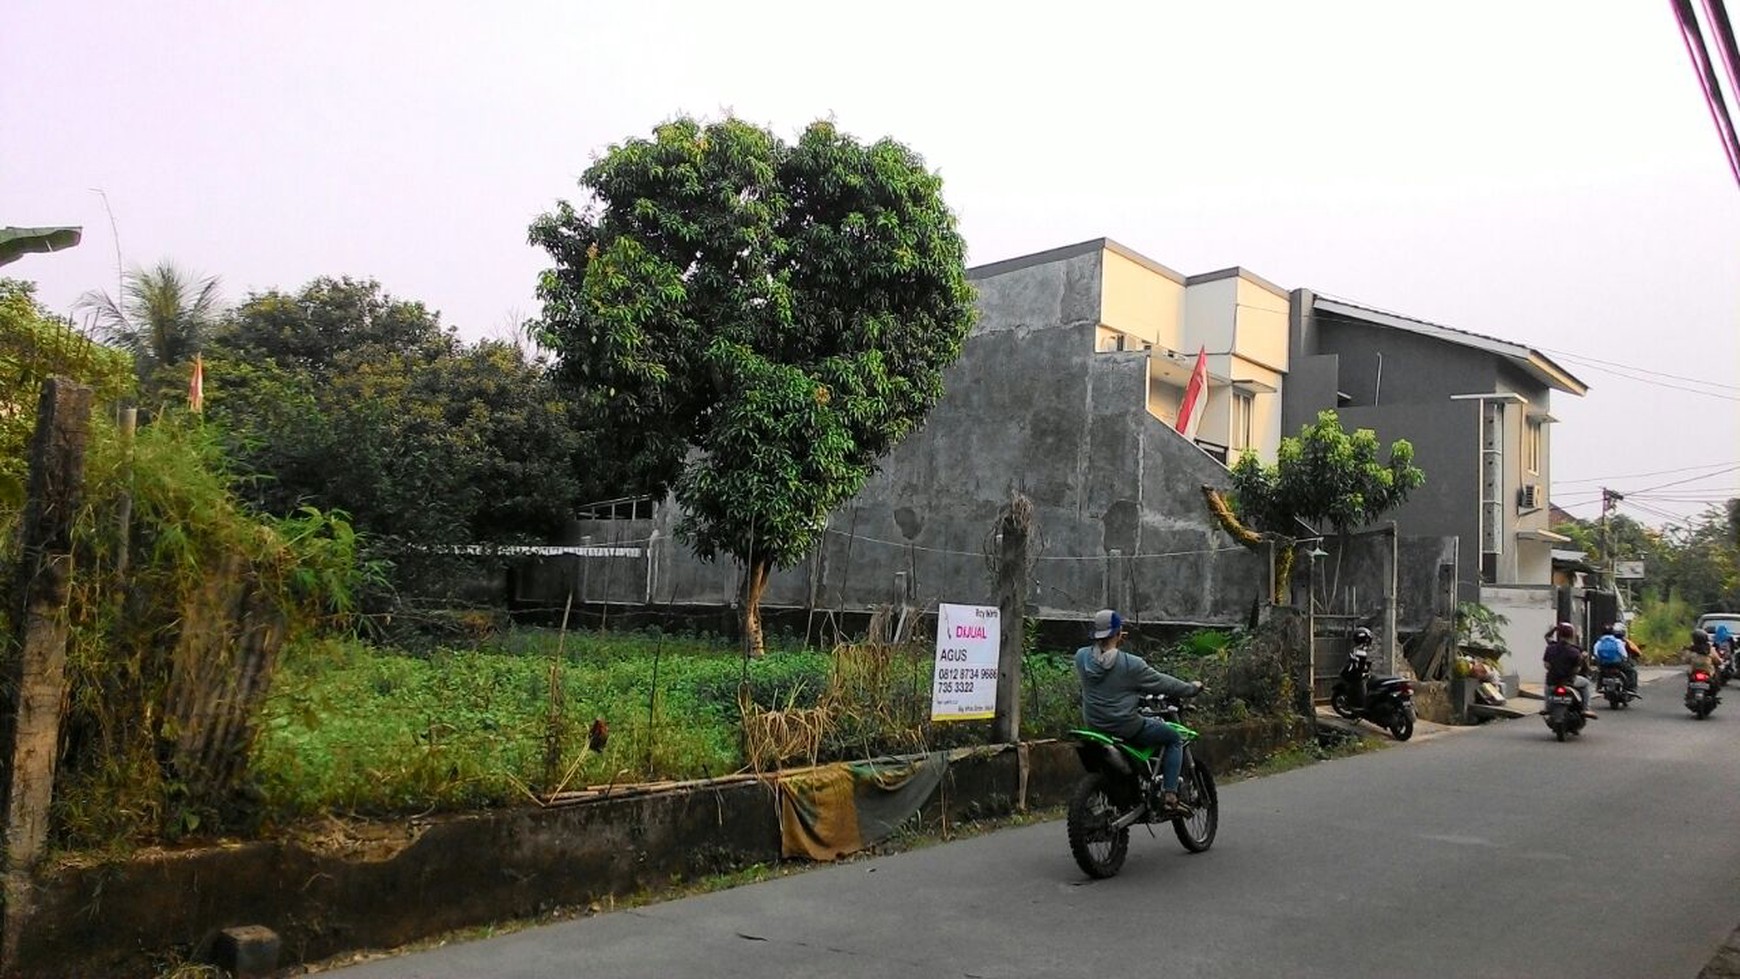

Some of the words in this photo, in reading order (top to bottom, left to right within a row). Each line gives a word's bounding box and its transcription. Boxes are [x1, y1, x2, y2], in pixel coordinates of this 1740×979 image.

[956, 626, 987, 639] DIJUAL
[940, 649, 967, 661] AGUS
[939, 668, 958, 680] 0812
[960, 668, 979, 680] 8734
[938, 682, 953, 693] 735
[954, 682, 974, 693] 3322
